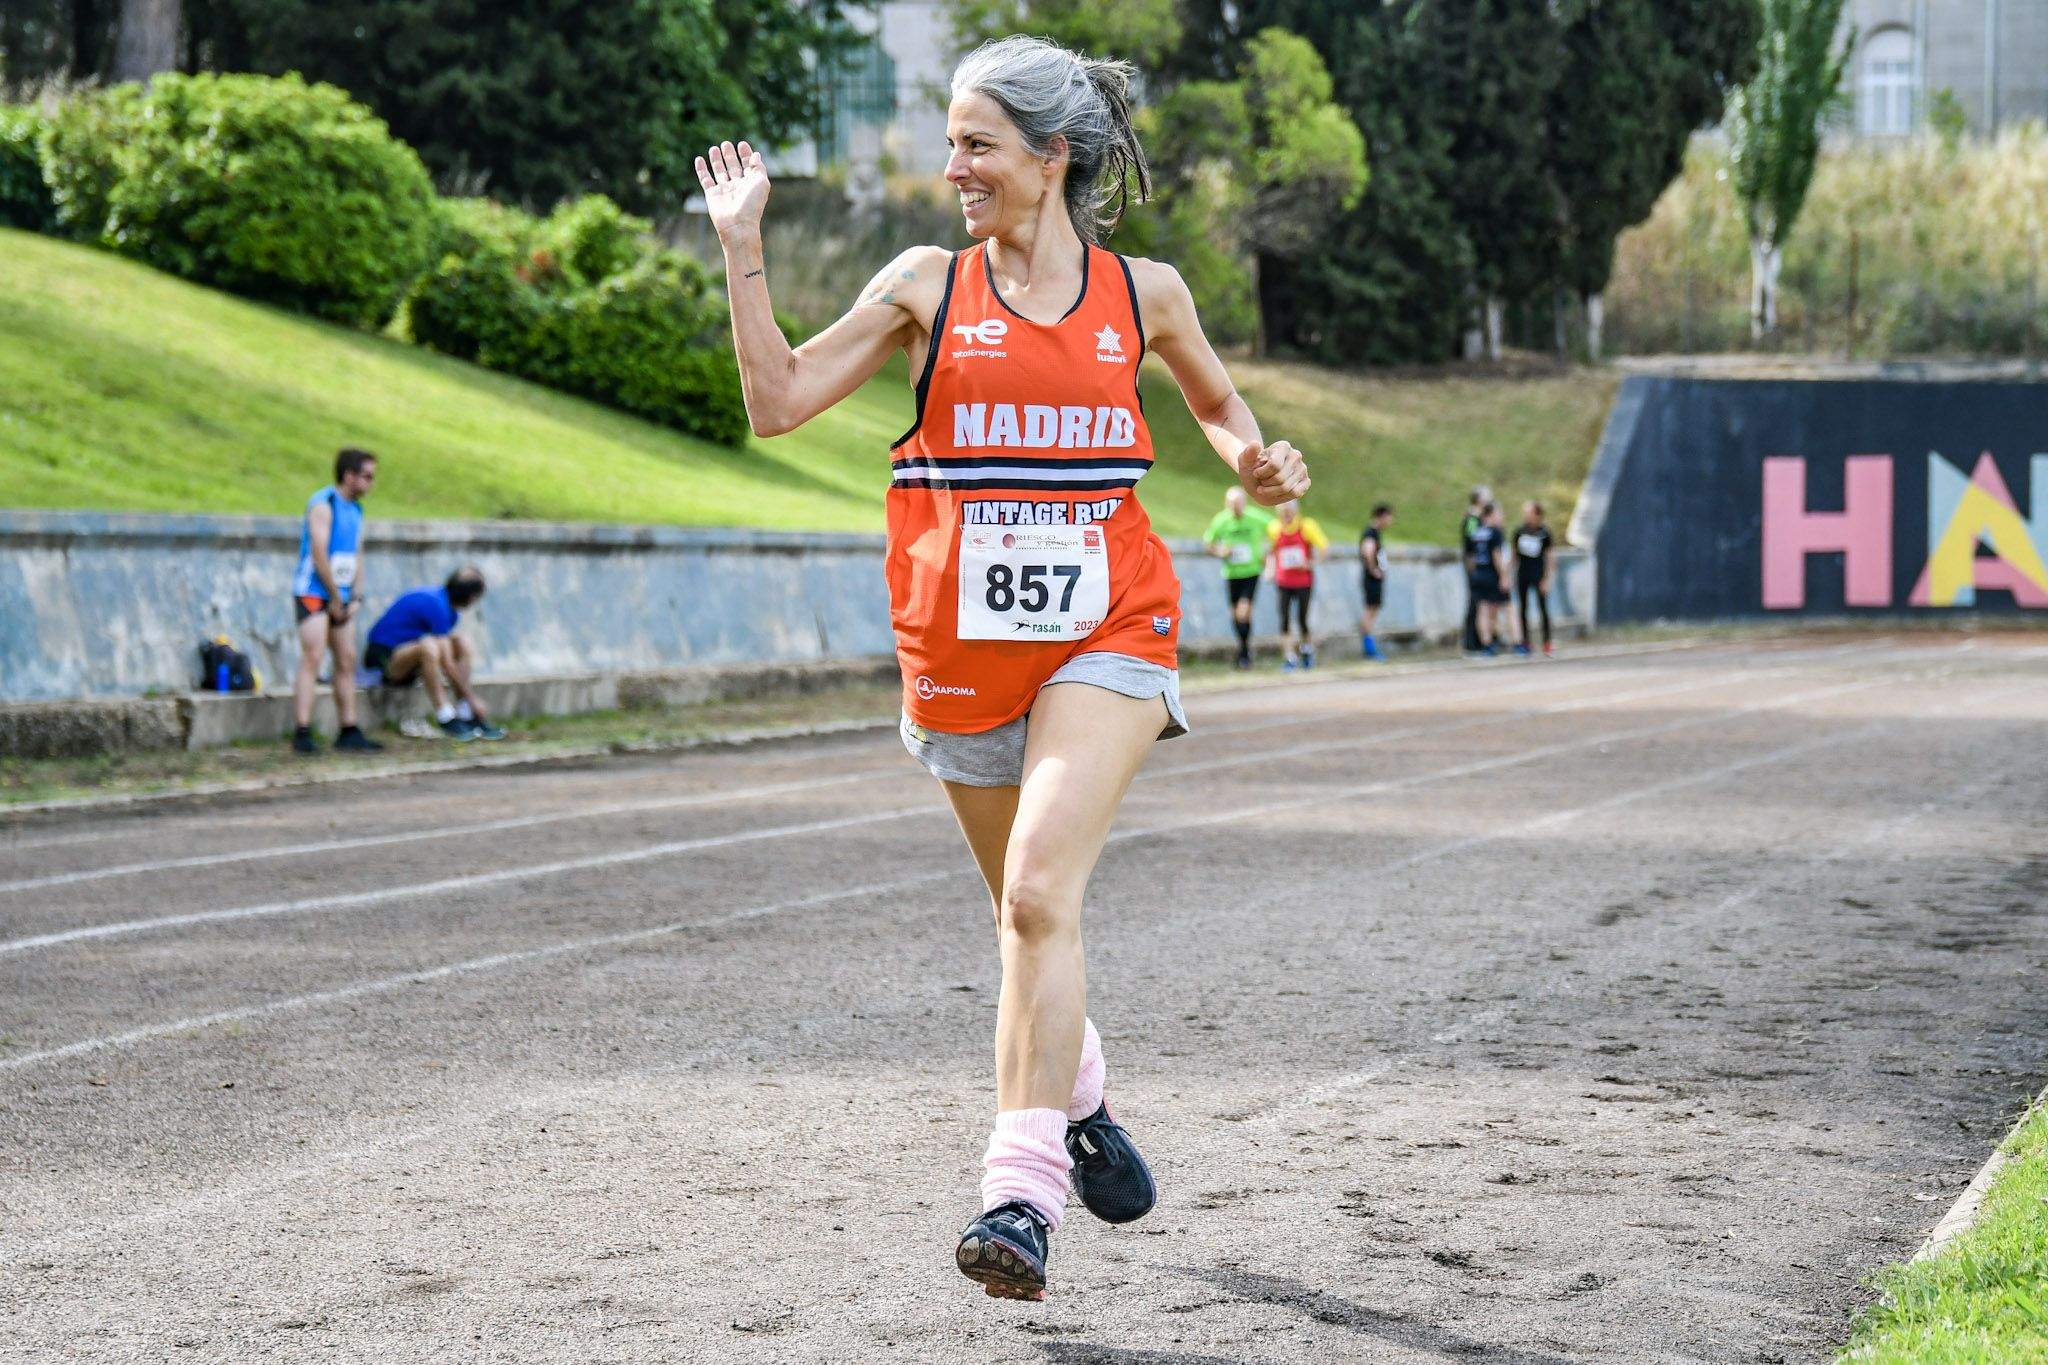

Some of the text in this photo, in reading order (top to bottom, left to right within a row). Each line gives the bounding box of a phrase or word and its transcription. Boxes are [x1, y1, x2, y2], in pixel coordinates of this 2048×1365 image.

[953, 403, 1136, 448] MADRID
[962, 501, 1068, 525] VINTAGE
[985, 563, 1082, 613] 857
[1032, 621, 1061, 633] rasán
[1073, 620, 1099, 632] 2023
[932, 685, 976, 696] MAPOMA
